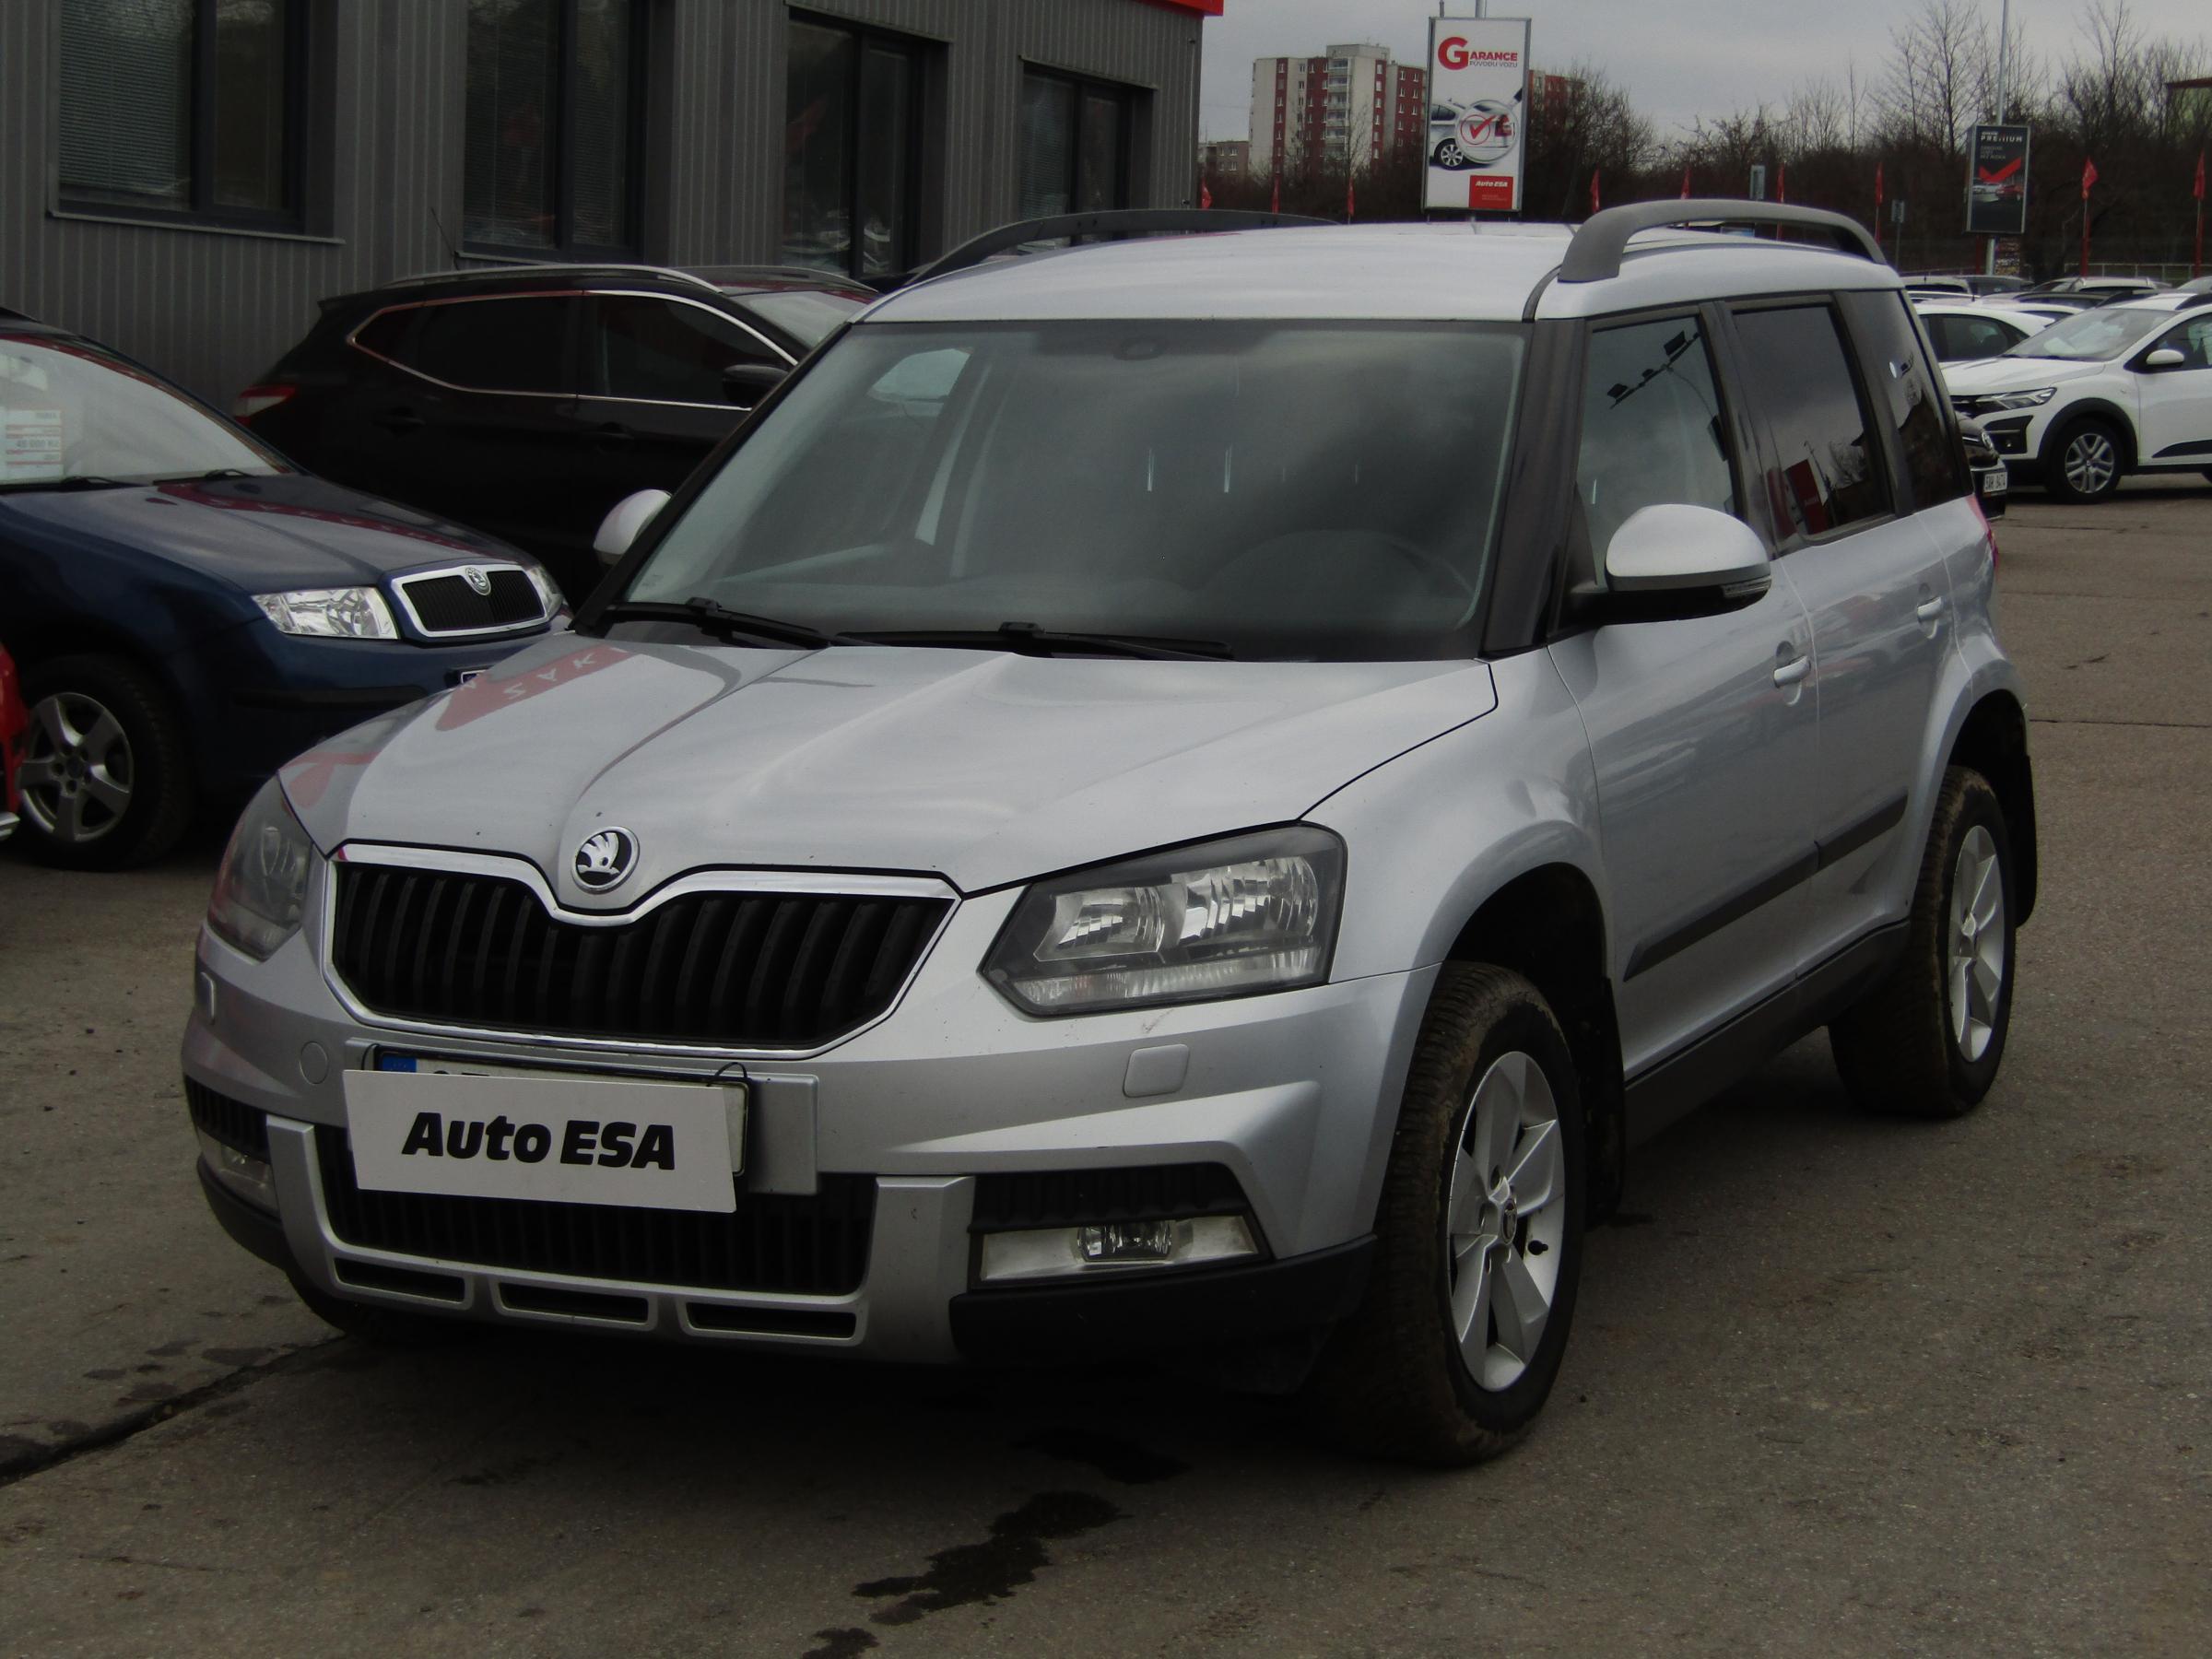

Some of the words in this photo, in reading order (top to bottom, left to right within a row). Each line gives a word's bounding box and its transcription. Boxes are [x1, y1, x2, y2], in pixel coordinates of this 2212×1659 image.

[1438, 36, 1518, 70] GARANCE
[401, 1112, 552, 1164] Auto
[559, 1119, 676, 1171] ESA
